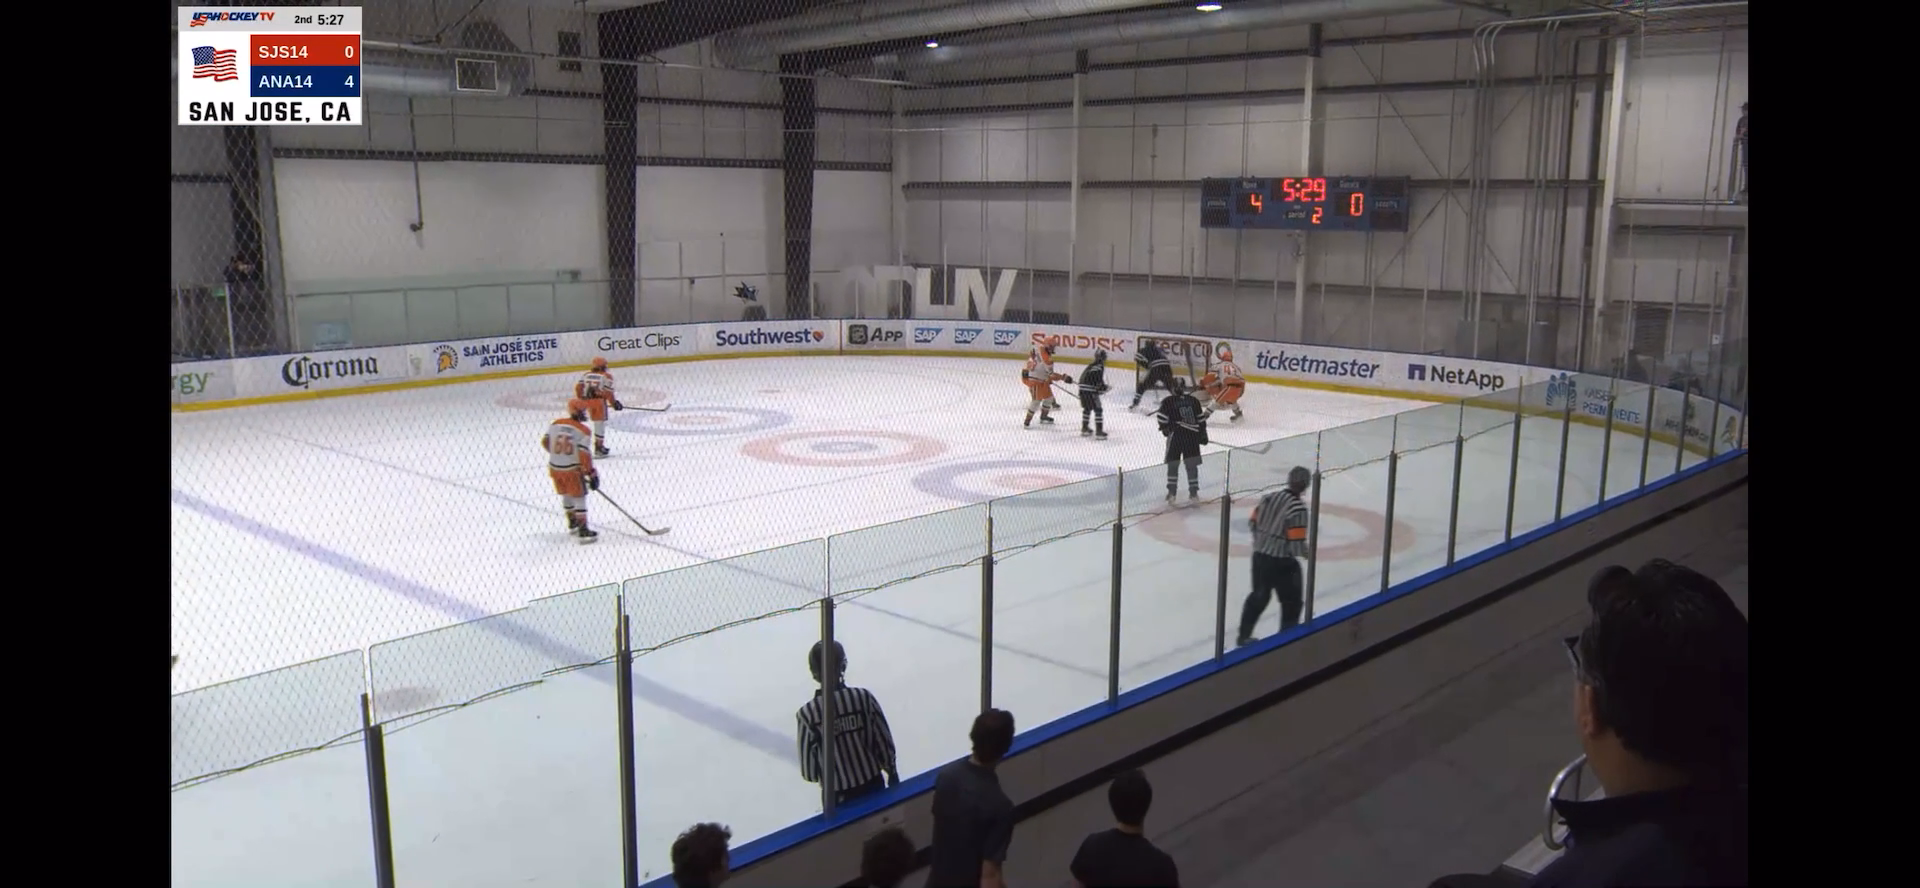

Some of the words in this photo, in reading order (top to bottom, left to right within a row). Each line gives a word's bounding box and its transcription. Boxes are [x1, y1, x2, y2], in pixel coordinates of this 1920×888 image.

[1283, 177, 1327, 202] 5:29
[1250, 192, 1263, 214] 4
[1349, 191, 1364, 217] 0
[1312, 207, 1323, 224] 2
[597, 335, 642, 351] Great
[644, 332, 680, 350] Clips
[715, 327, 812, 347] Southwest
[914, 329, 938, 341] SAP
[954, 330, 977, 342] SAP
[994, 331, 1017, 344] SAP
[463, 345, 490, 357] SAN
[492, 337, 523, 355] JOSÉ
[525, 338, 558, 350] STATE
[481, 351, 544, 367] ATHLETICS
[1255, 349, 1380, 380] ticketmaster
[281, 354, 379, 389] Corona
[1430, 364, 1505, 390] NetApp
[1583, 386, 1612, 401] KAISE
[1582, 401, 1641, 425] PERMNENTE
[833, 714, 863, 734] SHIDA
